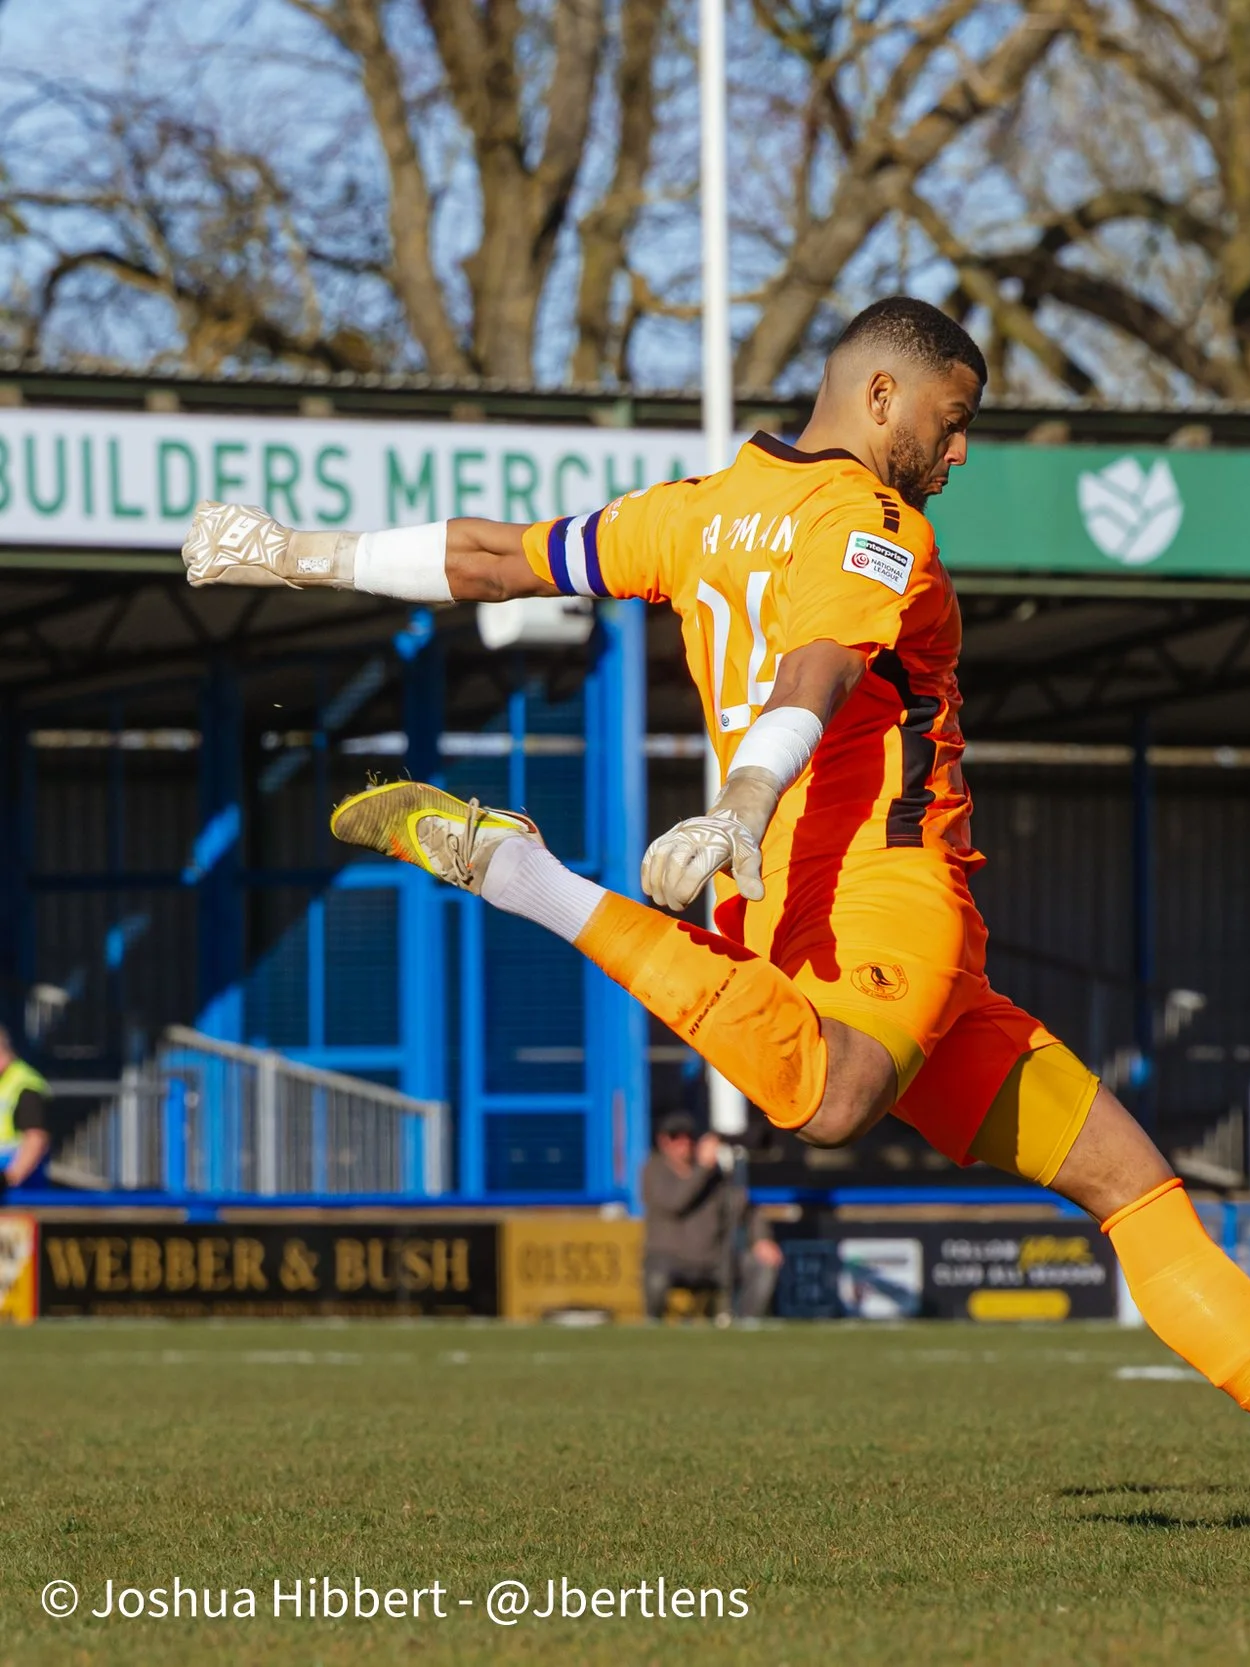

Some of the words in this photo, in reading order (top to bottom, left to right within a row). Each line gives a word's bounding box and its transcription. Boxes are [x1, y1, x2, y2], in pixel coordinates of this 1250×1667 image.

[871, 558, 904, 579] NATIONAL
[873, 565, 900, 582] LEAGUE
[46, 1238, 268, 1292] WEBBER
[280, 1239, 320, 1292] &
[335, 1239, 471, 1293] BUSH
